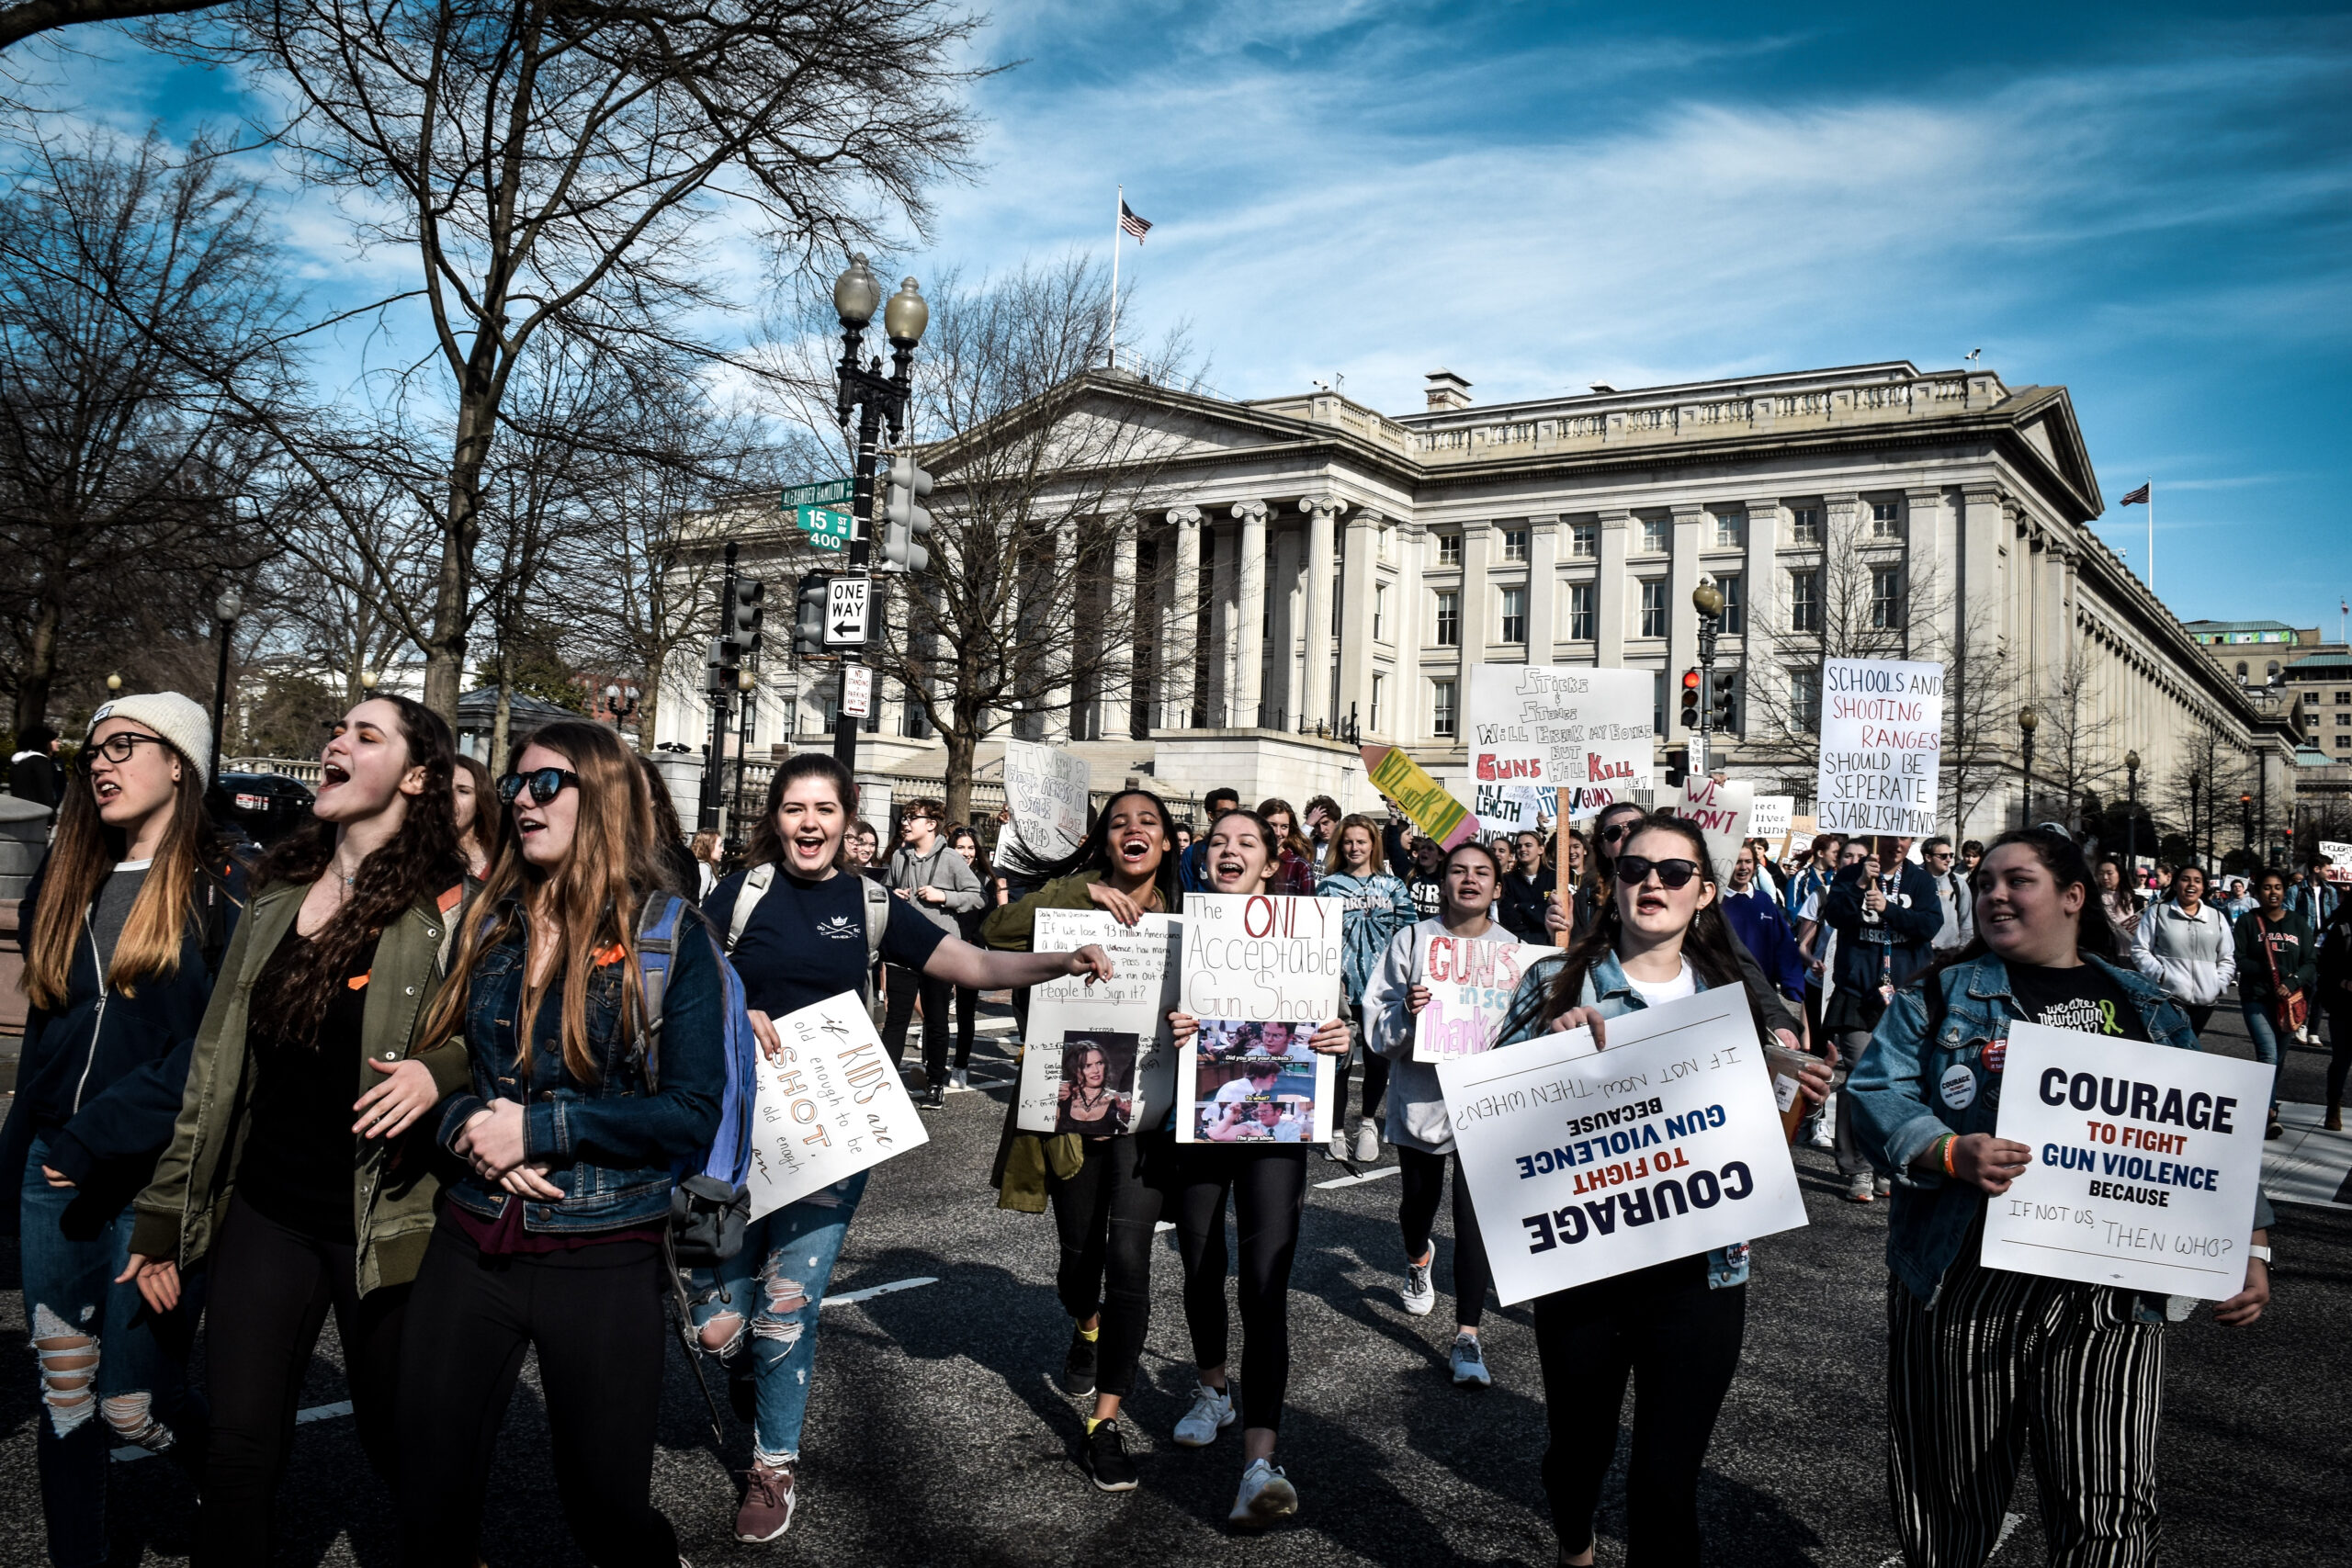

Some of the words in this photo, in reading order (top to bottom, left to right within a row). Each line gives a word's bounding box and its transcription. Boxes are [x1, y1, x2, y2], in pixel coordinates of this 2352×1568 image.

[784, 486, 815, 506] ALEXANDER
[816, 481, 844, 502] HAMILTON
[808, 510, 827, 530] 15
[837, 516, 847, 525] ST
[837, 525, 847, 535] NW
[810, 532, 840, 549] 400
[834, 584, 865, 599] ONE
[832, 602, 864, 617] WAY
[855, 670, 863, 678] NO
[1828, 666, 1905, 693] SCHOOLS
[1908, 674, 1942, 696] AND
[1520, 701, 1577, 723] STONES
[1833, 694, 1923, 722] SHOOTING
[1536, 725, 1584, 744] BREAK
[1589, 724, 1608, 740] MY
[1610, 723, 1654, 740] BONES
[1861, 724, 1939, 750] RANGES
[1010, 740, 1035, 774] I
[1075, 761, 1085, 790] 2
[1551, 746, 1582, 761] BUT
[1825, 751, 1891, 774] SHOULD
[1902, 753, 1927, 775] BE
[1476, 753, 1542, 781] GUNS
[1588, 752, 1634, 783] KILL
[1017, 783, 1051, 819] STAGE
[1582, 787, 1614, 808] GUNS
[1687, 778, 1717, 807] WE
[1832, 774, 1928, 803] SEPERATE
[1075, 791, 1085, 814] A
[1476, 795, 1521, 823] LENGTH
[1058, 807, 1082, 831] NOT
[1678, 807, 1738, 834] WONT
[1819, 801, 1936, 835] ESTABLISHMENTS
[1038, 911, 1051, 919] Daily
[1186, 896, 1222, 919] The
[1244, 895, 1332, 939] ONLY
[1343, 897, 1395, 911] IRGINIA
[1041, 922, 1057, 935] If
[1080, 924, 1097, 937] lose
[1104, 924, 1116, 937] 93
[1145, 928, 1181, 939] Americans
[1042, 942, 1047, 950] a
[1054, 939, 1068, 952] day
[1136, 945, 1148, 953] how
[1152, 946, 1170, 957] many
[1188, 924, 1336, 983] Acceptable
[1143, 972, 1157, 981] out
[1160, 972, 1169, 981] of
[1157, 961, 1172, 972] gun
[1429, 937, 1521, 990] GUNS
[1040, 980, 1079, 1004] People
[1084, 984, 1093, 998] to
[1130, 985, 1147, 999] it?
[1189, 971, 1240, 1018] Gun
[1250, 970, 1329, 1020] Show
[1459, 987, 1478, 1005] in
[2037, 1007, 2105, 1027] newtown
[2045, 1003, 2069, 1014] we
[2068, 998, 2097, 1010] are
[1660, 1057, 1700, 1085] NOT
[1709, 1045, 1742, 1071] IF
[794, 1021, 816, 1042] old
[809, 1057, 845, 1107] enough
[835, 1112, 851, 1127] to
[847, 1135, 864, 1154] be
[820, 1012, 849, 1045] if
[837, 1043, 891, 1104] KIDS
[866, 1113, 893, 1150] are
[1531, 1077, 1594, 1105] THEN
[1941, 1075, 1971, 1090] COURAGE
[1455, 1089, 1525, 1132] WHEN?
[2039, 1067, 2238, 1134] COURAGE
[763, 1106, 781, 1122] old
[1566, 1096, 1663, 1137] BECAUSE
[1665, 1103, 1727, 1141] GUN
[1514, 1121, 1661, 1179] VIOLENCE
[2086, 1121, 2117, 1145] TO
[2122, 1126, 2188, 1156] FIGHT
[1654, 1146, 1689, 1173] TO
[2041, 1143, 2097, 1173] GUN
[2102, 1151, 2220, 1192] VIOLENCE
[1573, 1156, 1650, 1196] FIGHT
[2088, 1179, 2170, 1207] BECAUSE
[1521, 1159, 1755, 1255] COURAGE
[2008, 1200, 2030, 1218] IF
[2035, 1203, 2071, 1222] NOT
[2102, 1219, 2166, 1251] THEN
[2175, 1235, 2234, 1258] WHO?
